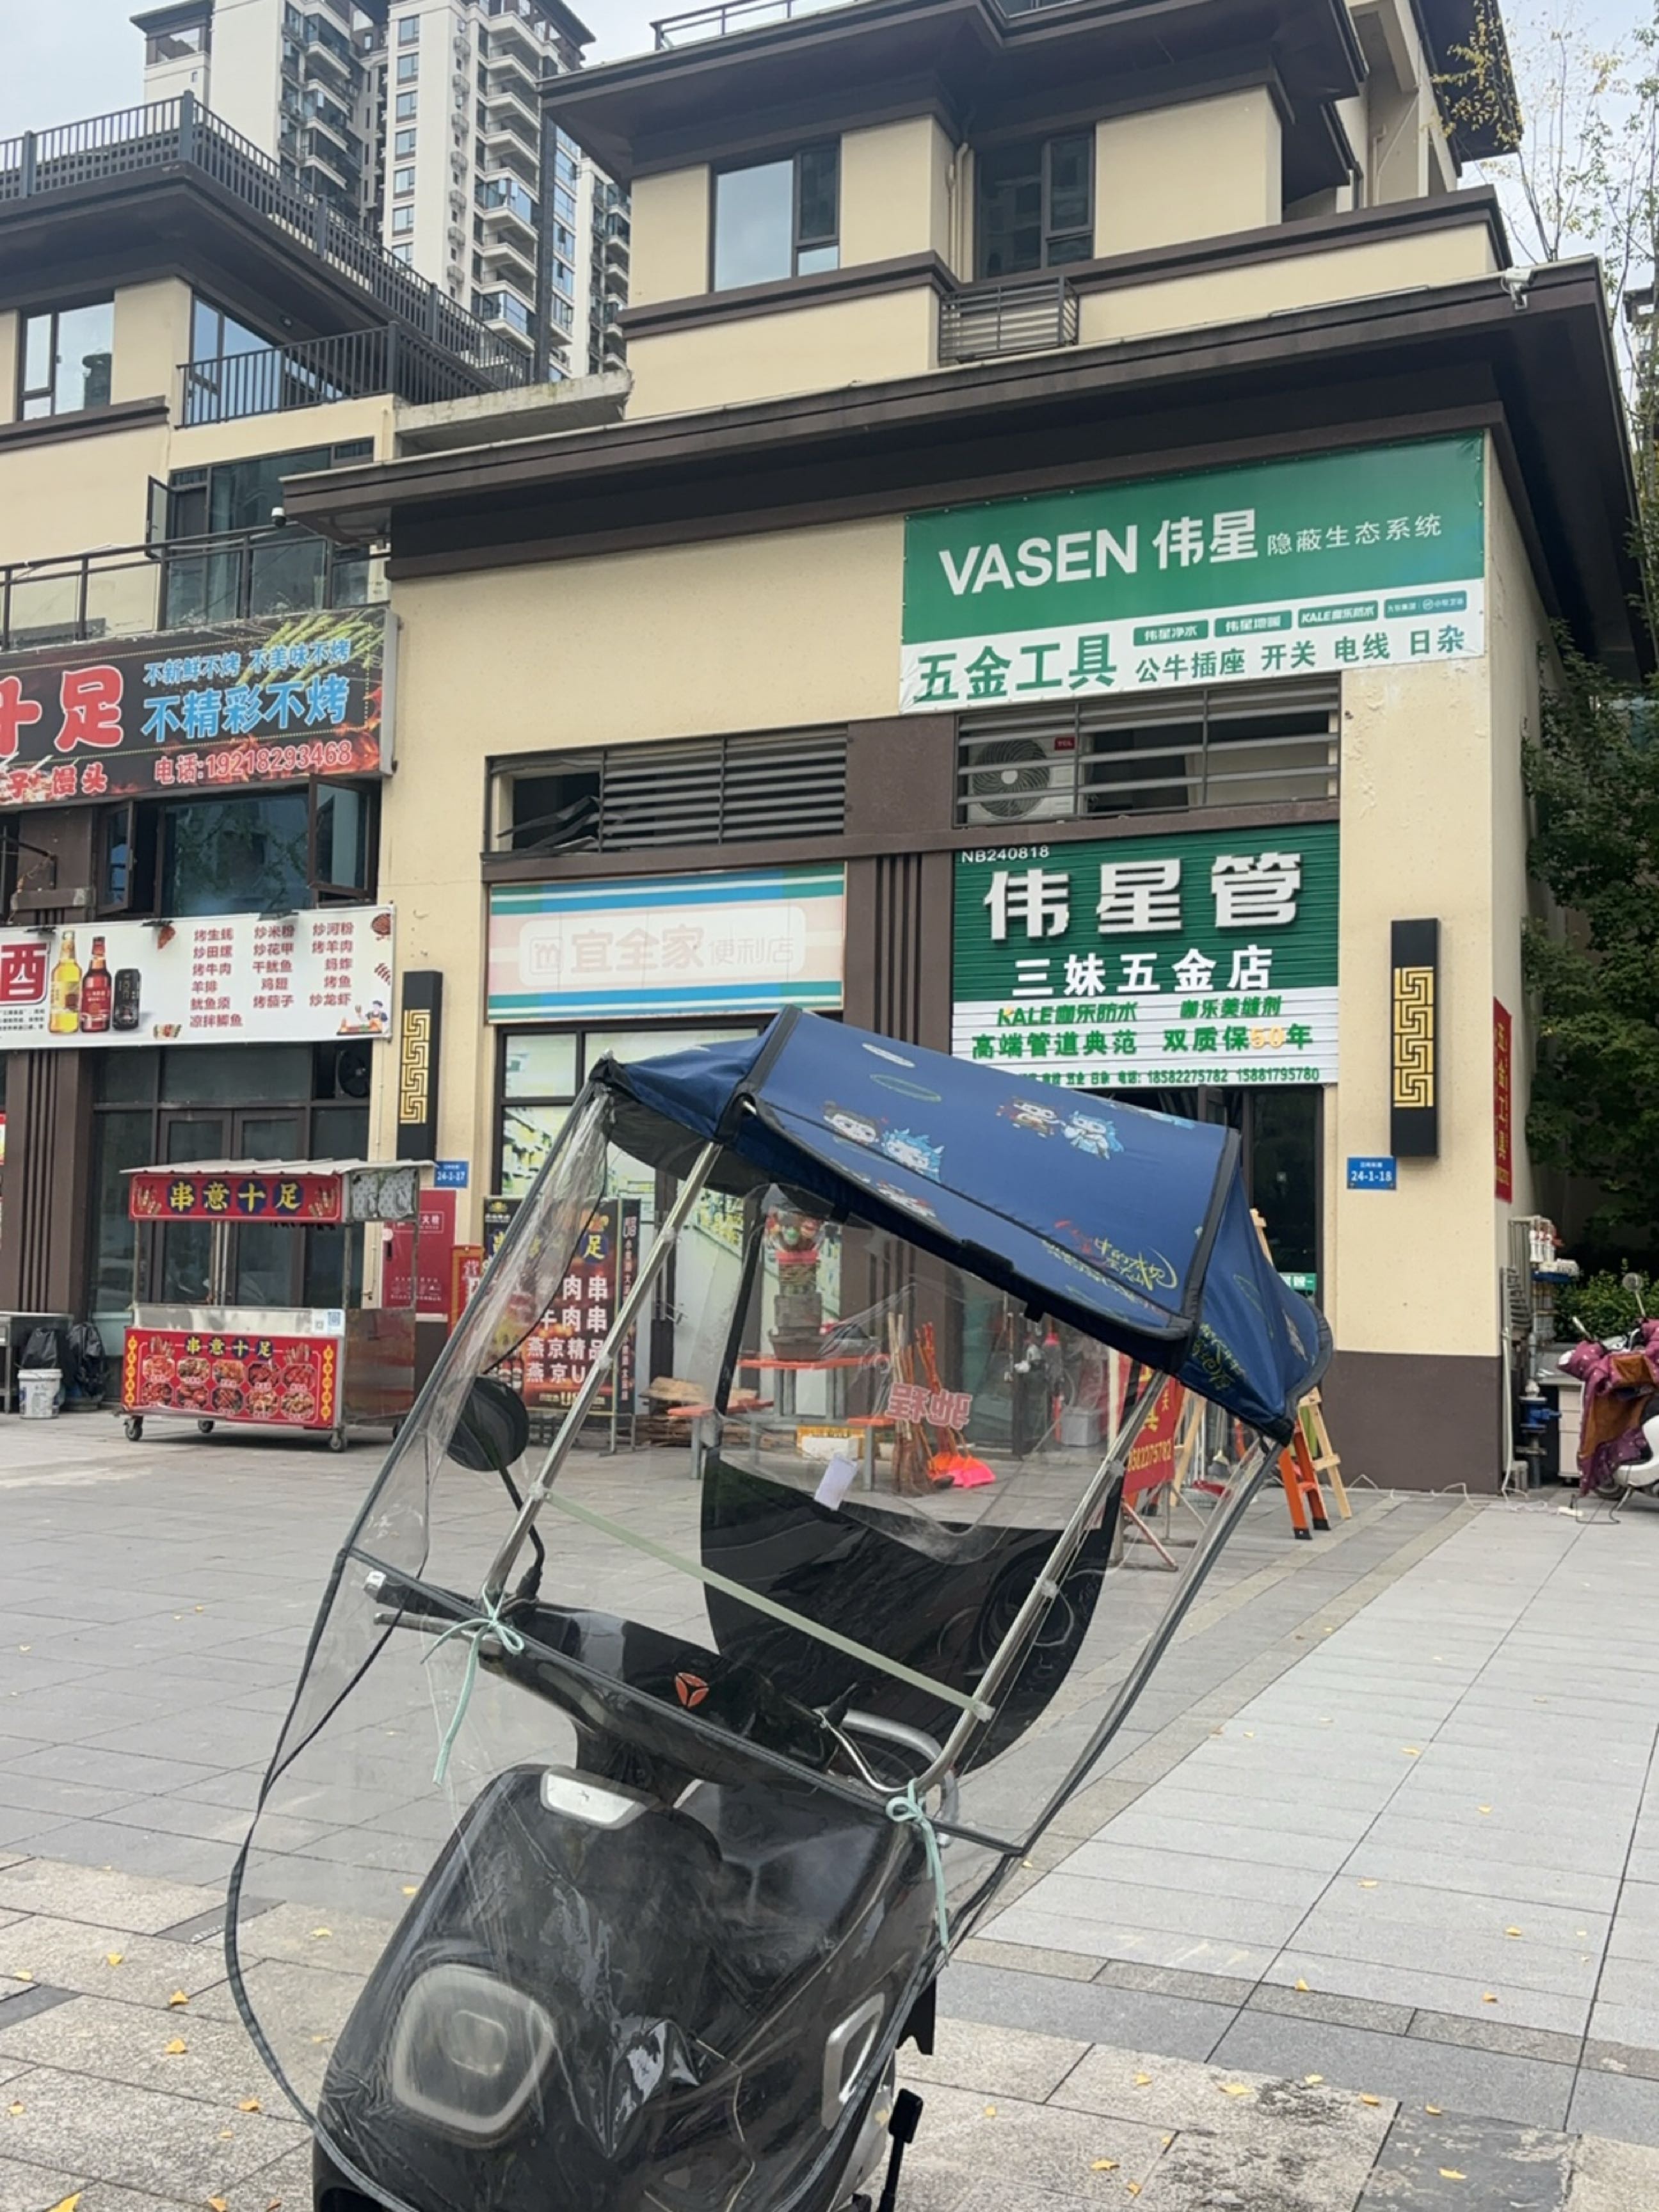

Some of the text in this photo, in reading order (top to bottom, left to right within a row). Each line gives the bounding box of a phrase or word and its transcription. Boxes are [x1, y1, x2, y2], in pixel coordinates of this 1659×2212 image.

[938, 508, 1443, 596] VASEN 伟星 隐蔽生态系统
[912, 623, 1466, 705] 五金工具 公牛插座 开关 电线 日杂
[140, 671, 350, 743] 不精彩不烤
[961, 846, 1050, 863] NB240818
[983, 851, 1302, 942] 伟星管
[571, 924, 795, 974] 宜全家 便利店
[1012, 944, 1272, 997] 三妹五金店
[972, 1023, 1313, 1060] 高端管道典范 双质保50年
[1148, 1068, 1228, 1084] 18582275782
[1237, 1066, 1319, 1082] 15881795780
[1351, 1170, 1393, 1182] 24-1-18
[169, 1182, 302, 1213] 串意十足
[186, 1339, 272, 1358] 串意十足
[525, 1362, 586, 1384] 燕京U
